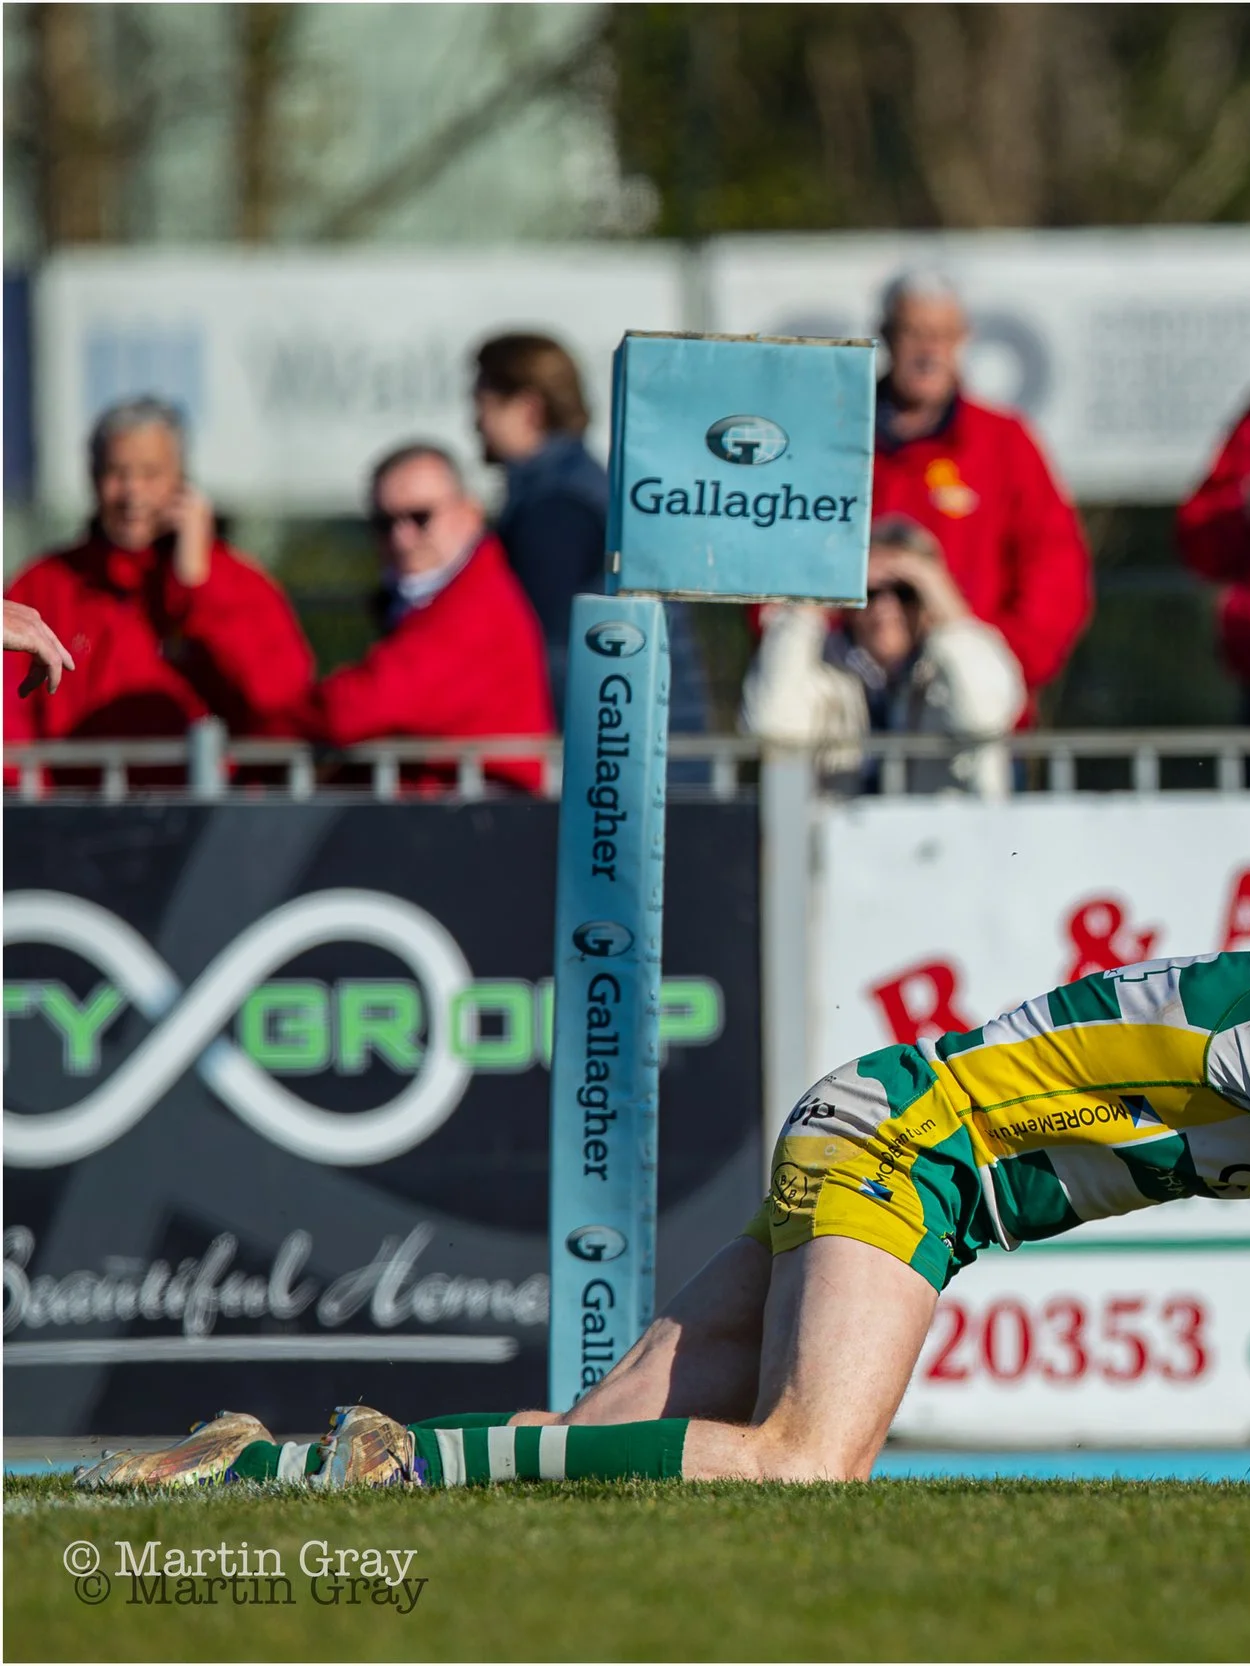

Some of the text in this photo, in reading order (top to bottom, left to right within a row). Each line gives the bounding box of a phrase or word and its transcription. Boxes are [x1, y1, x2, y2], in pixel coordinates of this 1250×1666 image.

[630, 477, 858, 528] Gallagher
[587, 674, 633, 882] Gallagher
[239, 977, 726, 1076] GROP
[868, 957, 978, 1046] R
[1064, 896, 1162, 984] &
[576, 972, 621, 1182] Gallagher
[317, 1220, 550, 1328] Home
[573, 1278, 615, 1405] Galla
[923, 1296, 1212, 1382] 20353
